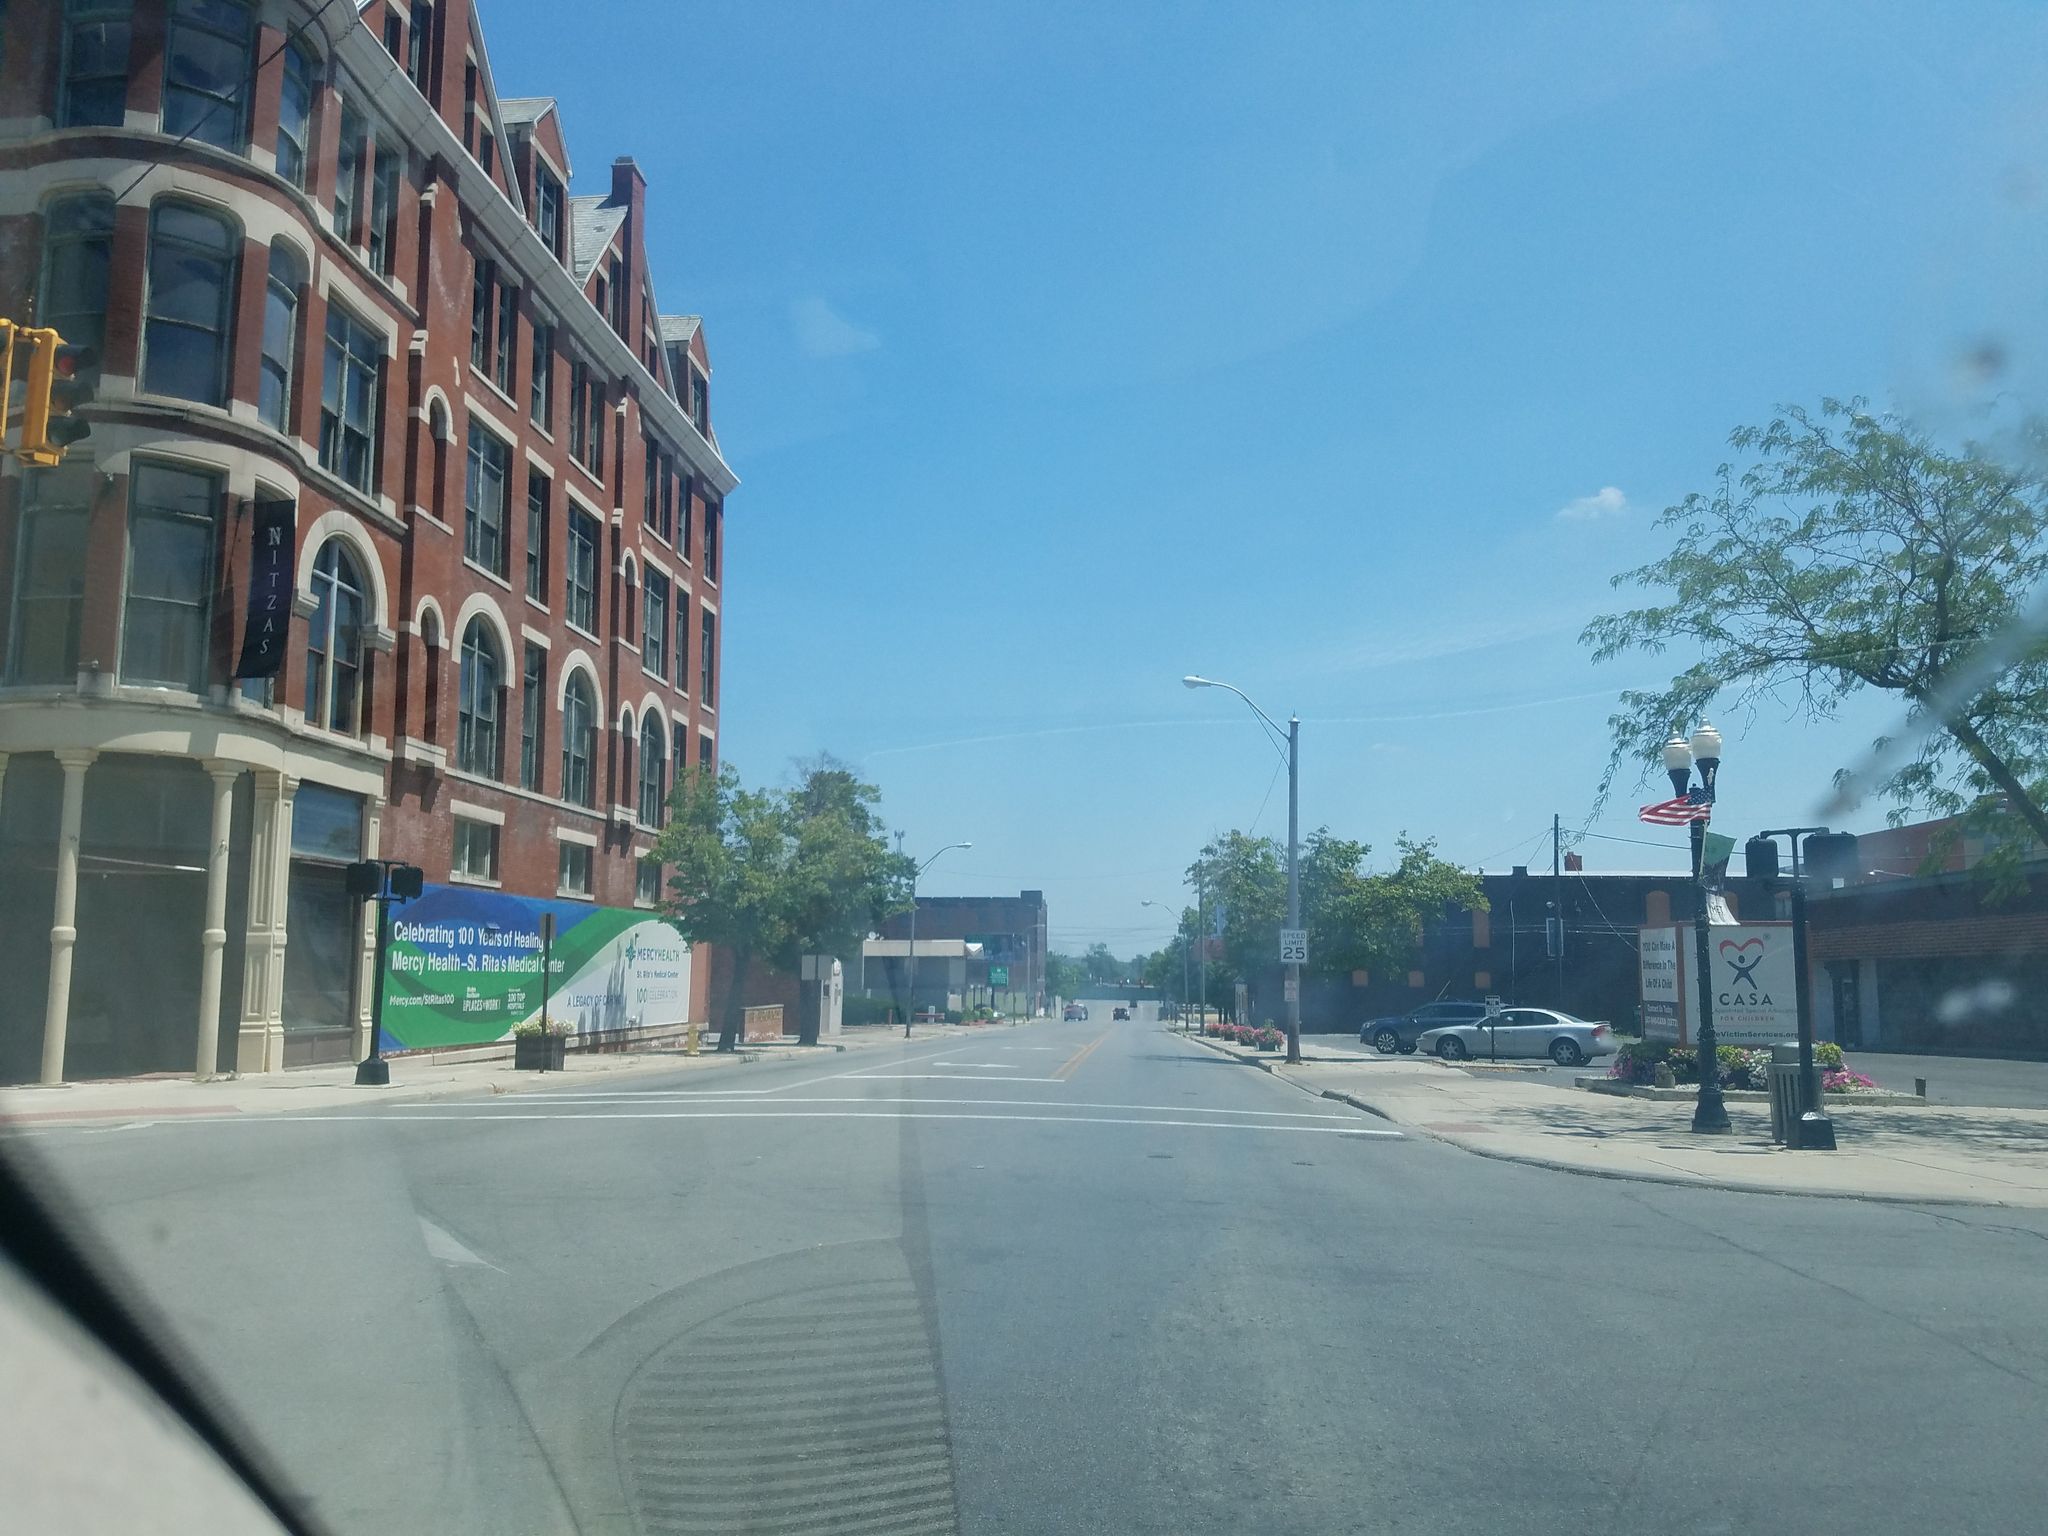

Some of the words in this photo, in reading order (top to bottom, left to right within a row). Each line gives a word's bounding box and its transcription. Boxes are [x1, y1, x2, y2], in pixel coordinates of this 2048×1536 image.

[259, 526, 282, 655] NITZAS
[394, 920, 454, 949] Celebrating
[458, 927, 474, 945] 100
[478, 927, 502, 947] Years
[503, 930, 513, 947] of
[514, 930, 544, 953] Healing
[1282, 932, 1306, 940] SPEED
[1283, 946, 1306, 960] 25
[392, 950, 426, 976] Mercy
[481, 954, 507, 973] Rita's
[507, 954, 539, 973] Medical
[540, 956, 565, 974] Cnter
[389, 993, 455, 1008] Mercy.com/StRitas100
[567, 995, 572, 1008] A
[572, 995, 594, 1008] LEGACY
[1719, 993, 1774, 1006] CASA
